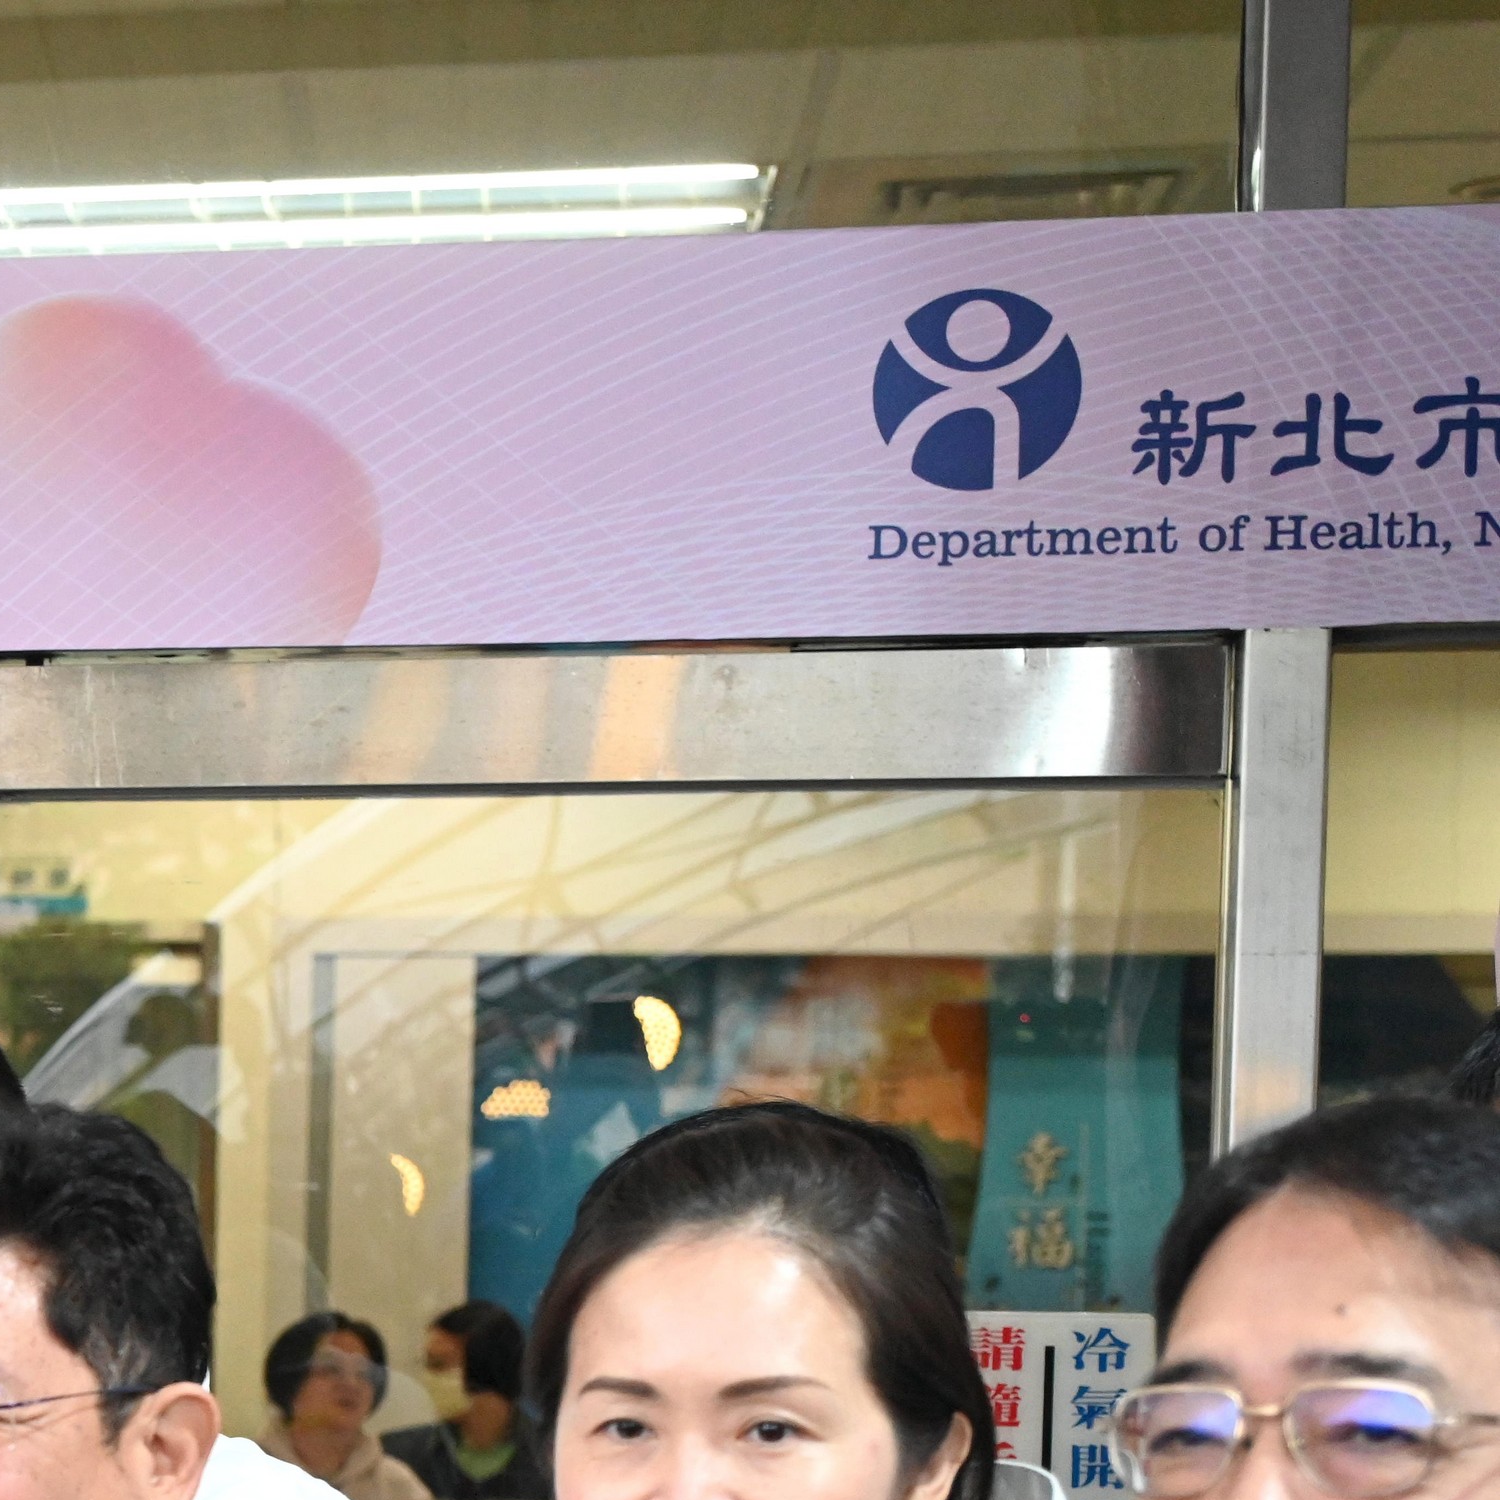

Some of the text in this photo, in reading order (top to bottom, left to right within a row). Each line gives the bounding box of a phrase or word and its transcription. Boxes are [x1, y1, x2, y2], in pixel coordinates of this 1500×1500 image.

[1131, 376, 1500, 486] 新北市
[867, 516, 1179, 567] Department
[1198, 513, 1252, 553] of
[1263, 510, 1454, 556] Health,
[970, 1326, 1026, 1460] 請隨
